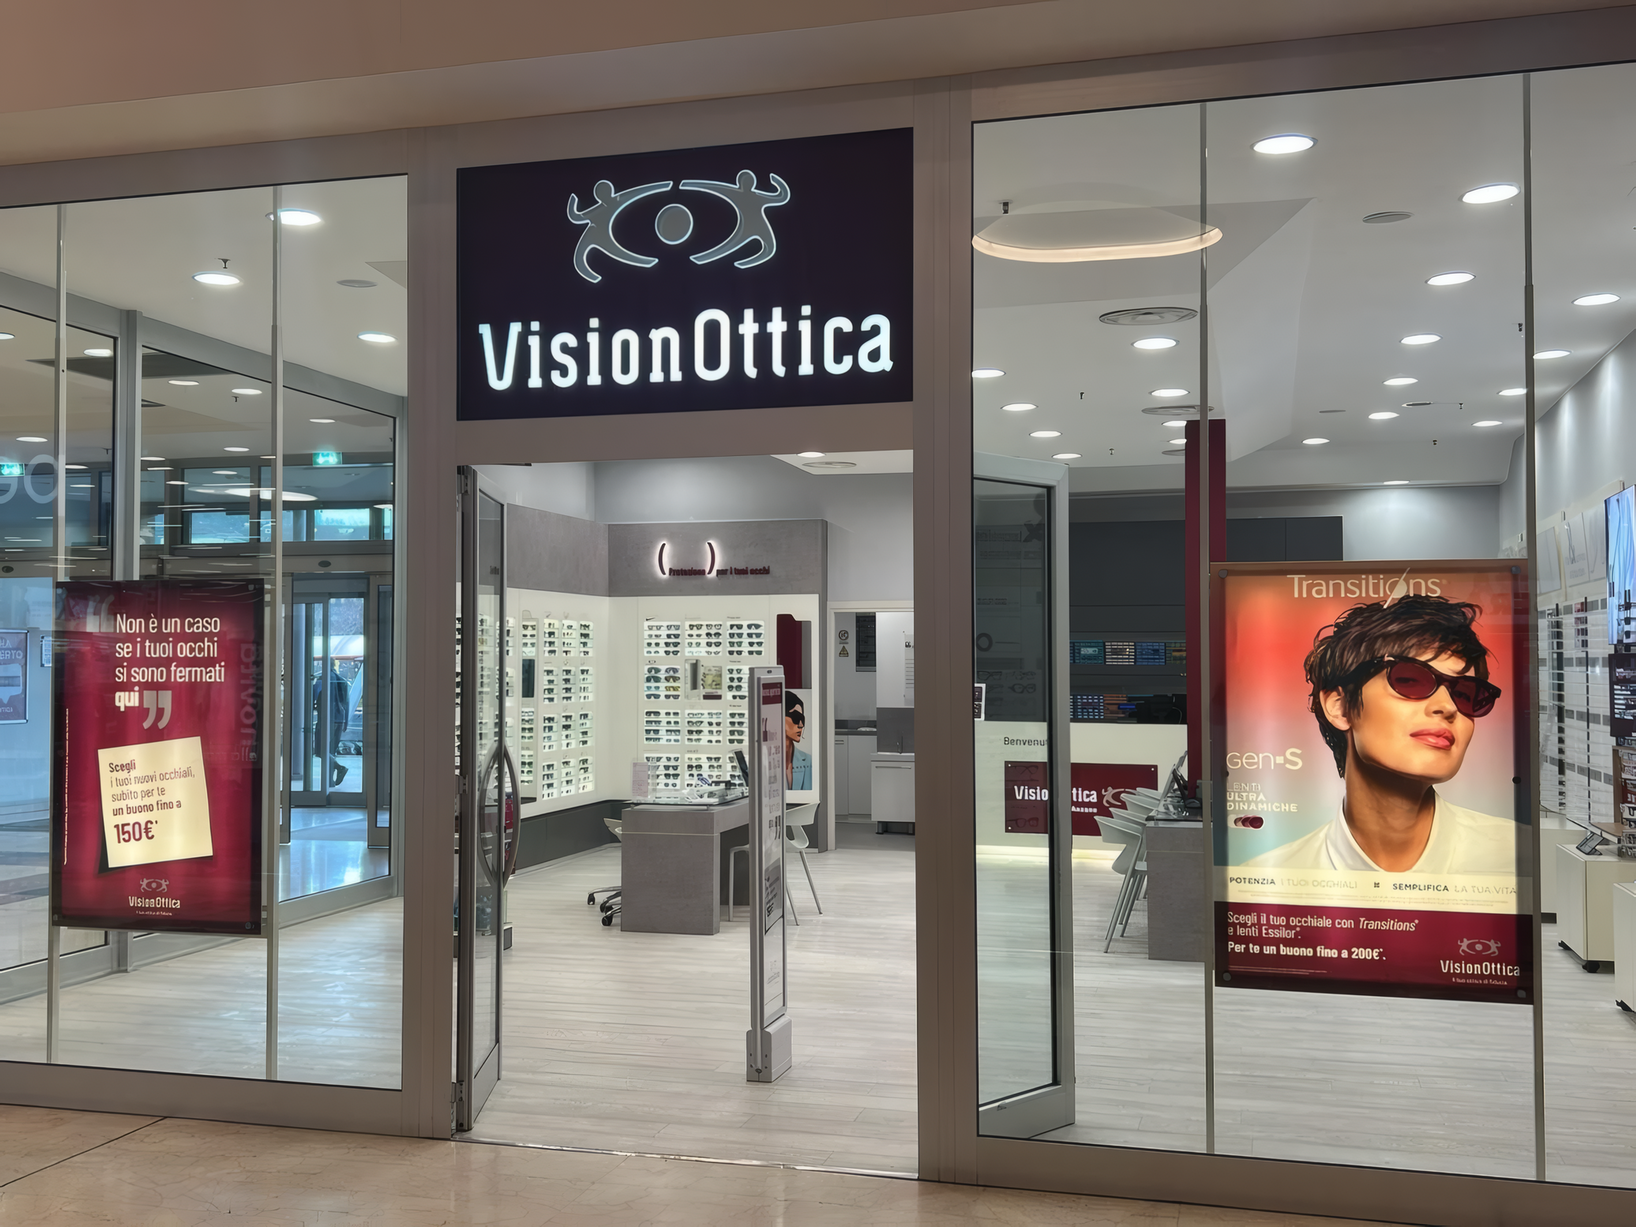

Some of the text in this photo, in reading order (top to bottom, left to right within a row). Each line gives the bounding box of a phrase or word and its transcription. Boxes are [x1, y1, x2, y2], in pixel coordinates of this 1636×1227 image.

[478, 304, 894, 391] VisionOttica
[117, 613, 220, 633] Non è un caso
[115, 637, 218, 658] se i tuoi occhi
[115, 661, 225, 682] si sono fermati
[108, 759, 136, 774] Scegli
[110, 776, 114, 788] i
[115, 774, 132, 788] tuoi
[112, 787, 166, 802] subito per te
[1226, 791, 1267, 802] ULTRA
[112, 800, 182, 816] un buono fino a
[1226, 802, 1298, 812] DINAMICHE
[1229, 876, 1276, 886] POTENZIA
[1392, 882, 1450, 892] SEMPLIFICA
[1227, 911, 1257, 925] Scegli
[1260, 913, 1267, 924] il
[1269, 914, 1287, 926] tuo
[1289, 915, 1332, 928] occhiale
[1335, 917, 1354, 929] con
[1227, 926, 1233, 936] e
[1237, 925, 1258, 937] lenti
[1227, 941, 1246, 953] Per
[1249, 943, 1260, 954] te
[1263, 944, 1277, 955] un
[1280, 944, 1313, 957] buono
[1316, 945, 1338, 958] fino
[1341, 948, 1348, 959] a
[1440, 959, 1520, 977] VisionOttica
